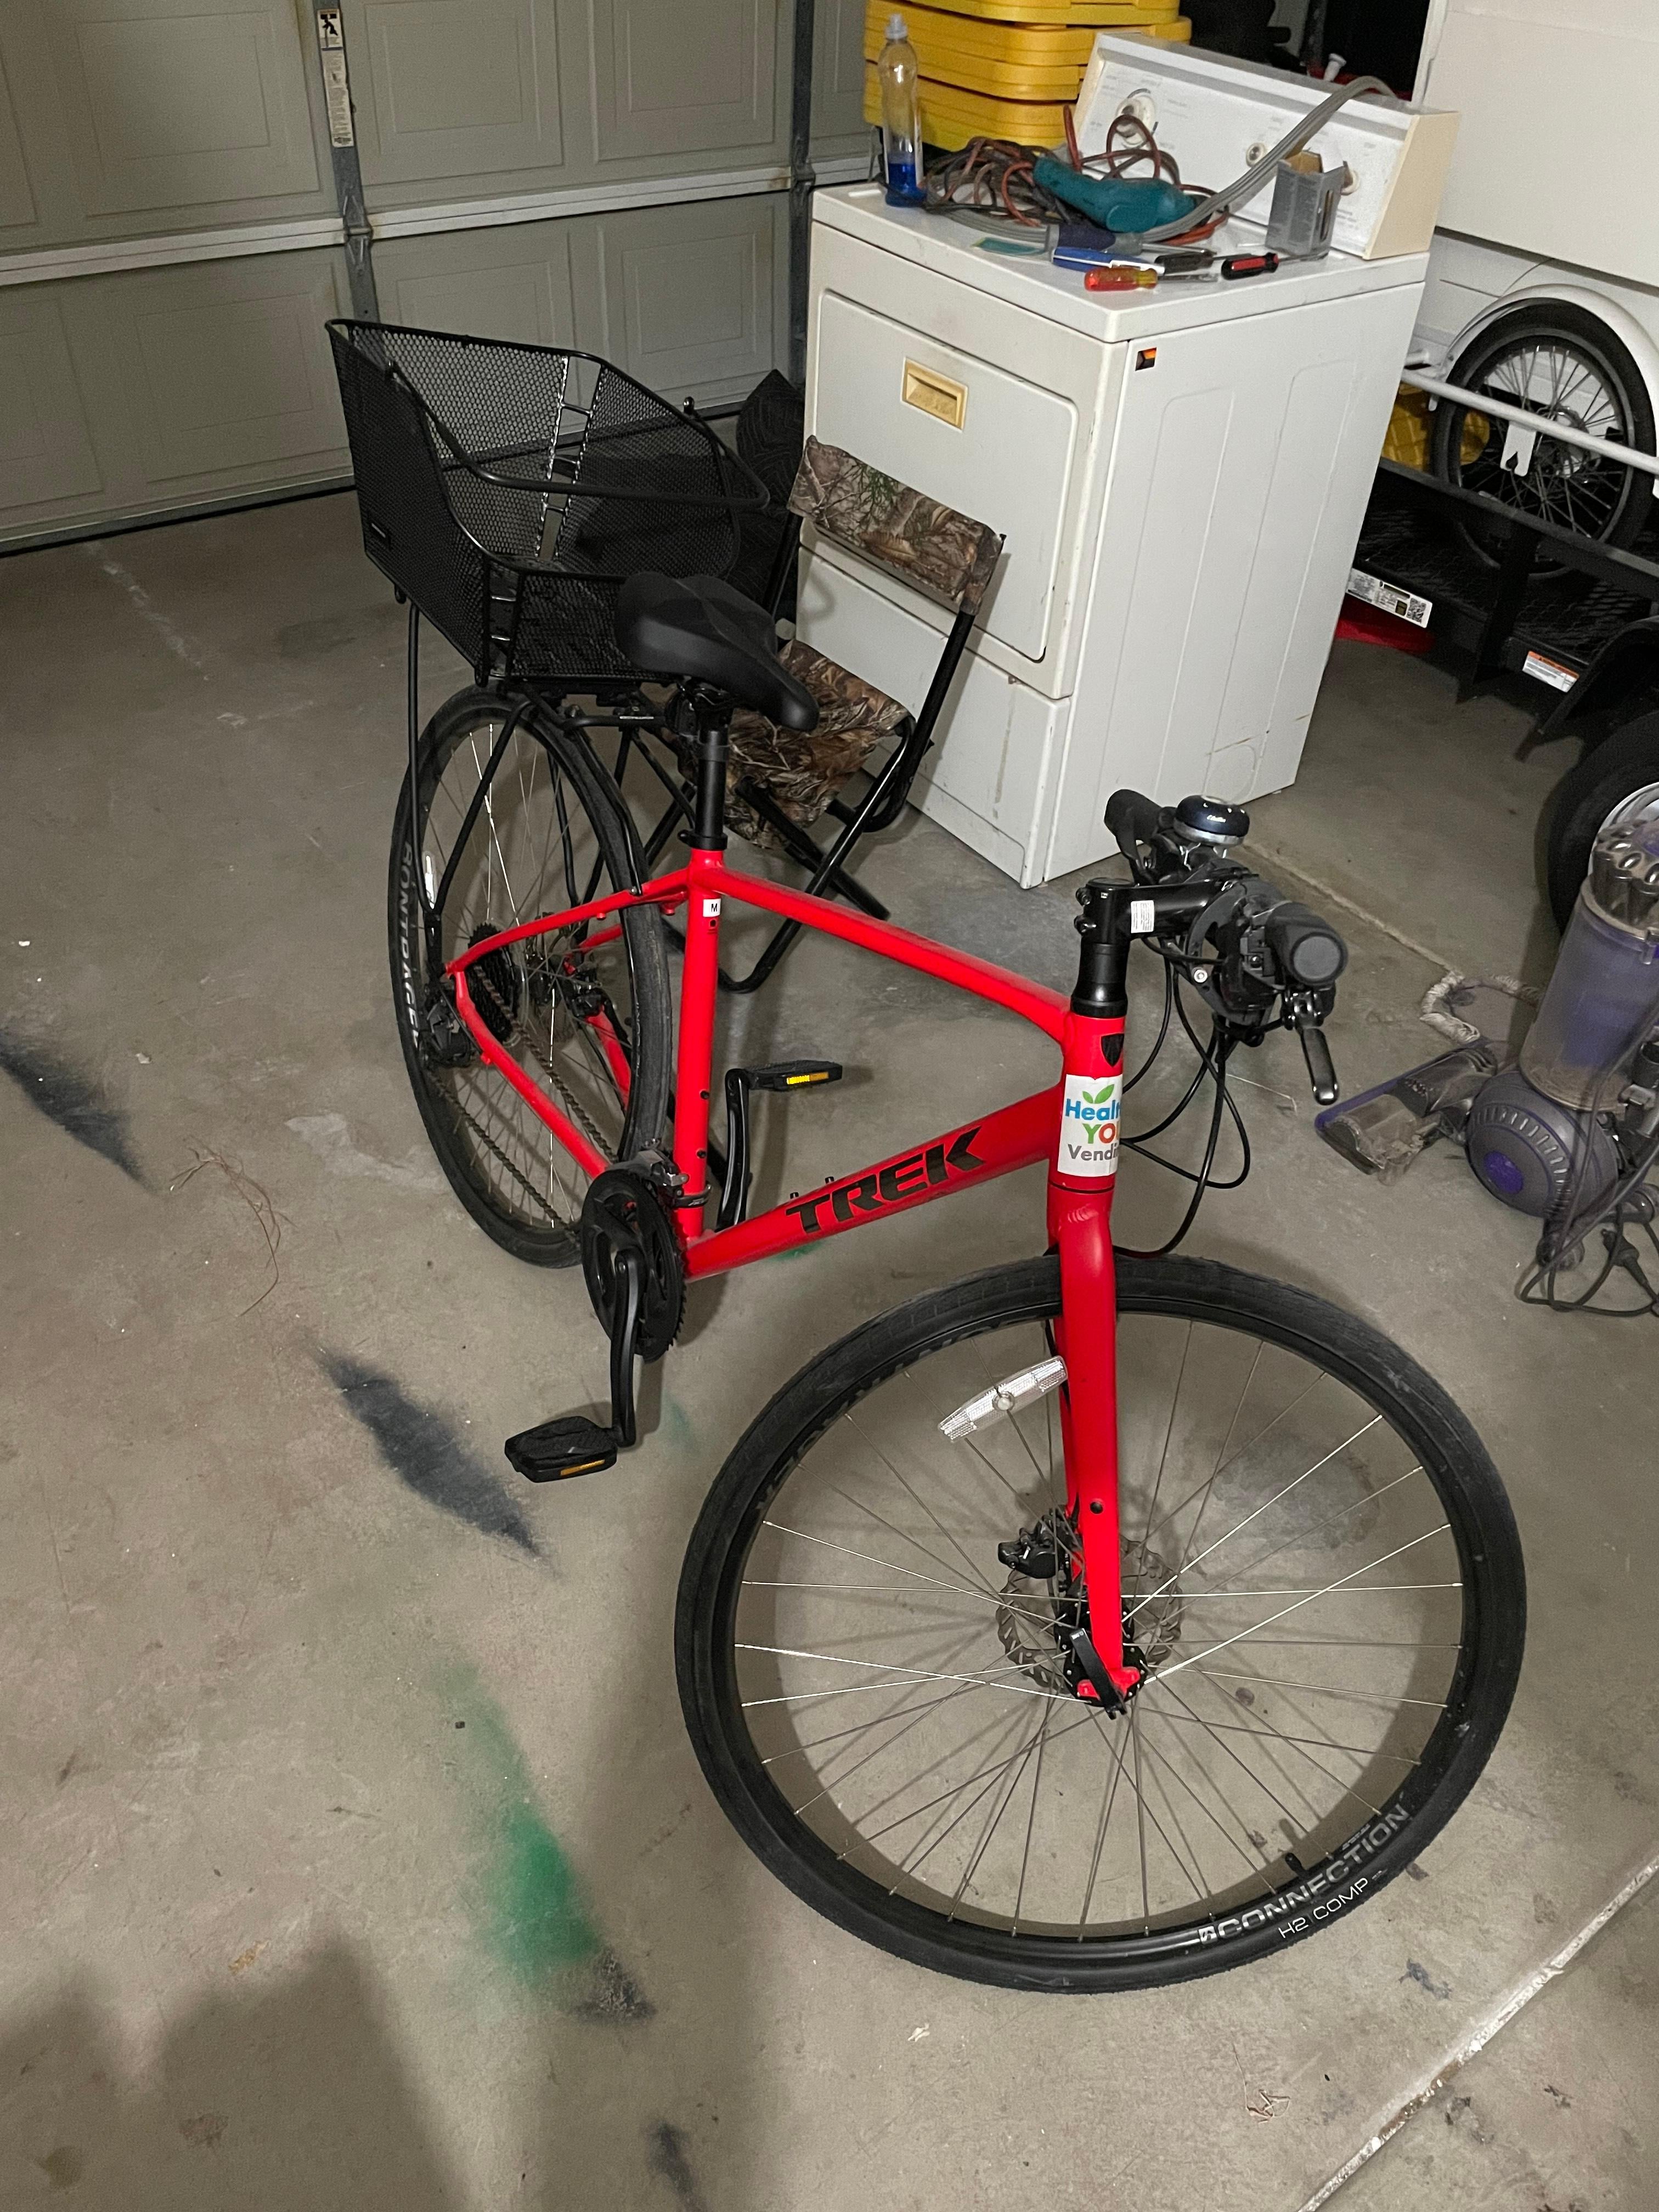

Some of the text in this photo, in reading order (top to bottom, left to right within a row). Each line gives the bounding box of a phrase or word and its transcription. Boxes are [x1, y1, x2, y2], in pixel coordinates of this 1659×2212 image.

[711, 903, 718, 912] M
[785, 1125, 986, 1234] TREK
[1068, 1143, 1118, 1161] Vendi
[1217, 1803, 1410, 1939] CONNECTION
[1278, 1877, 1368, 1939] H2 COMP
